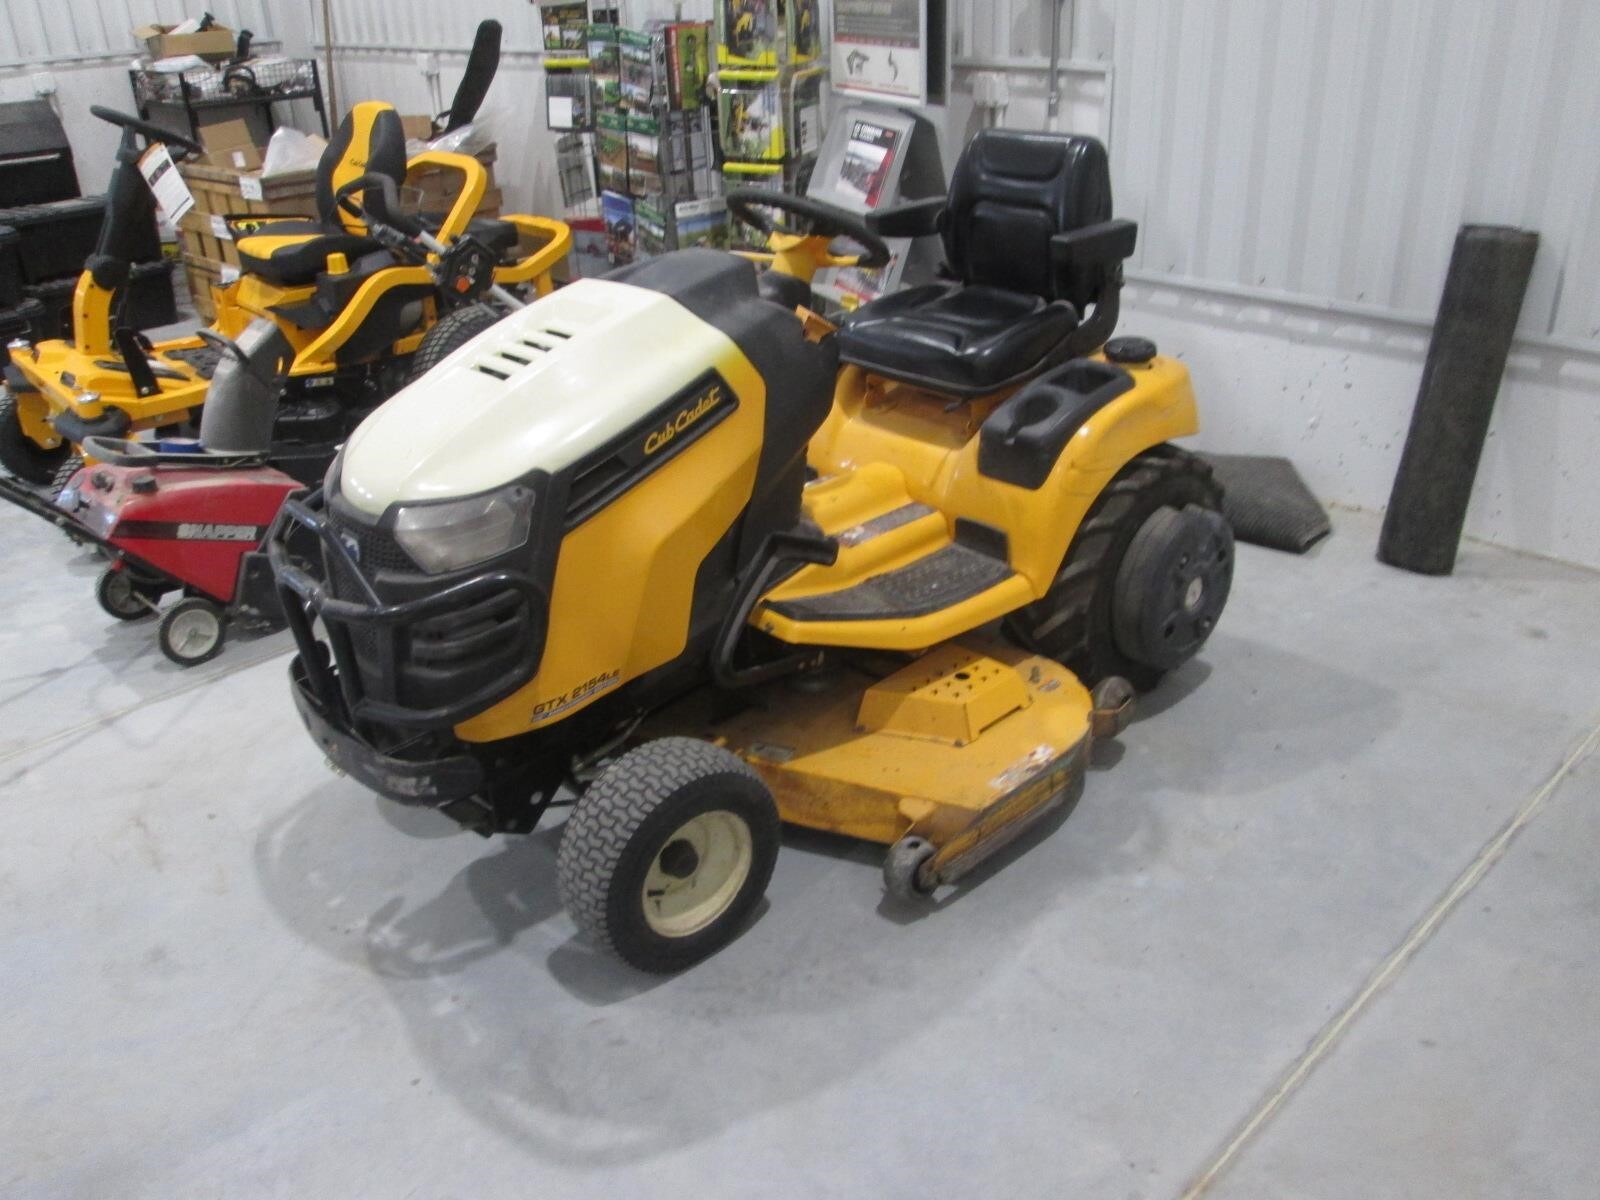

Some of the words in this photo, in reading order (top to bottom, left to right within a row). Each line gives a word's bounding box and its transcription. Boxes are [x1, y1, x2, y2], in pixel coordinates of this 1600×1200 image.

[644, 422, 675, 455] Cub
[675, 386, 720, 433] Cadet
[533, 693, 568, 715] GTX
